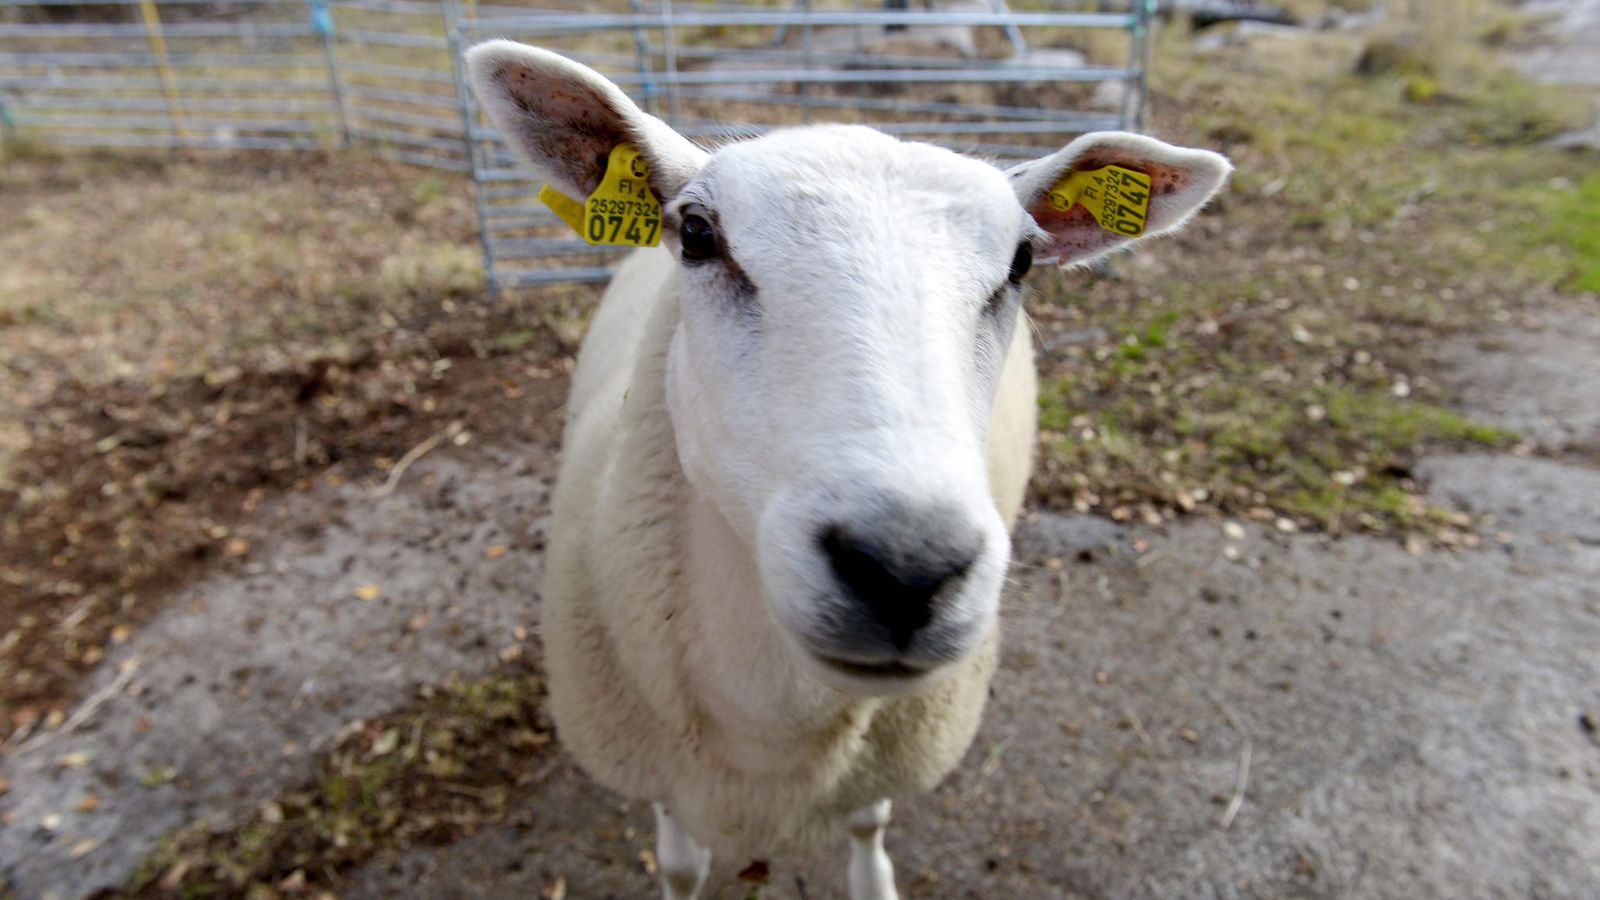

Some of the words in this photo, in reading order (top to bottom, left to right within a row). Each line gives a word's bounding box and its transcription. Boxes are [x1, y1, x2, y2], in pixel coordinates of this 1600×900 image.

[619, 180, 632, 193] FI
[637, 188, 646, 201] 4
[1093, 176, 1105, 185] 4
[590, 199, 660, 217] 25297324
[1101, 169, 1121, 229] 25297324
[1115, 173, 1149, 235] 0747
[589, 214, 659, 244] 0747
